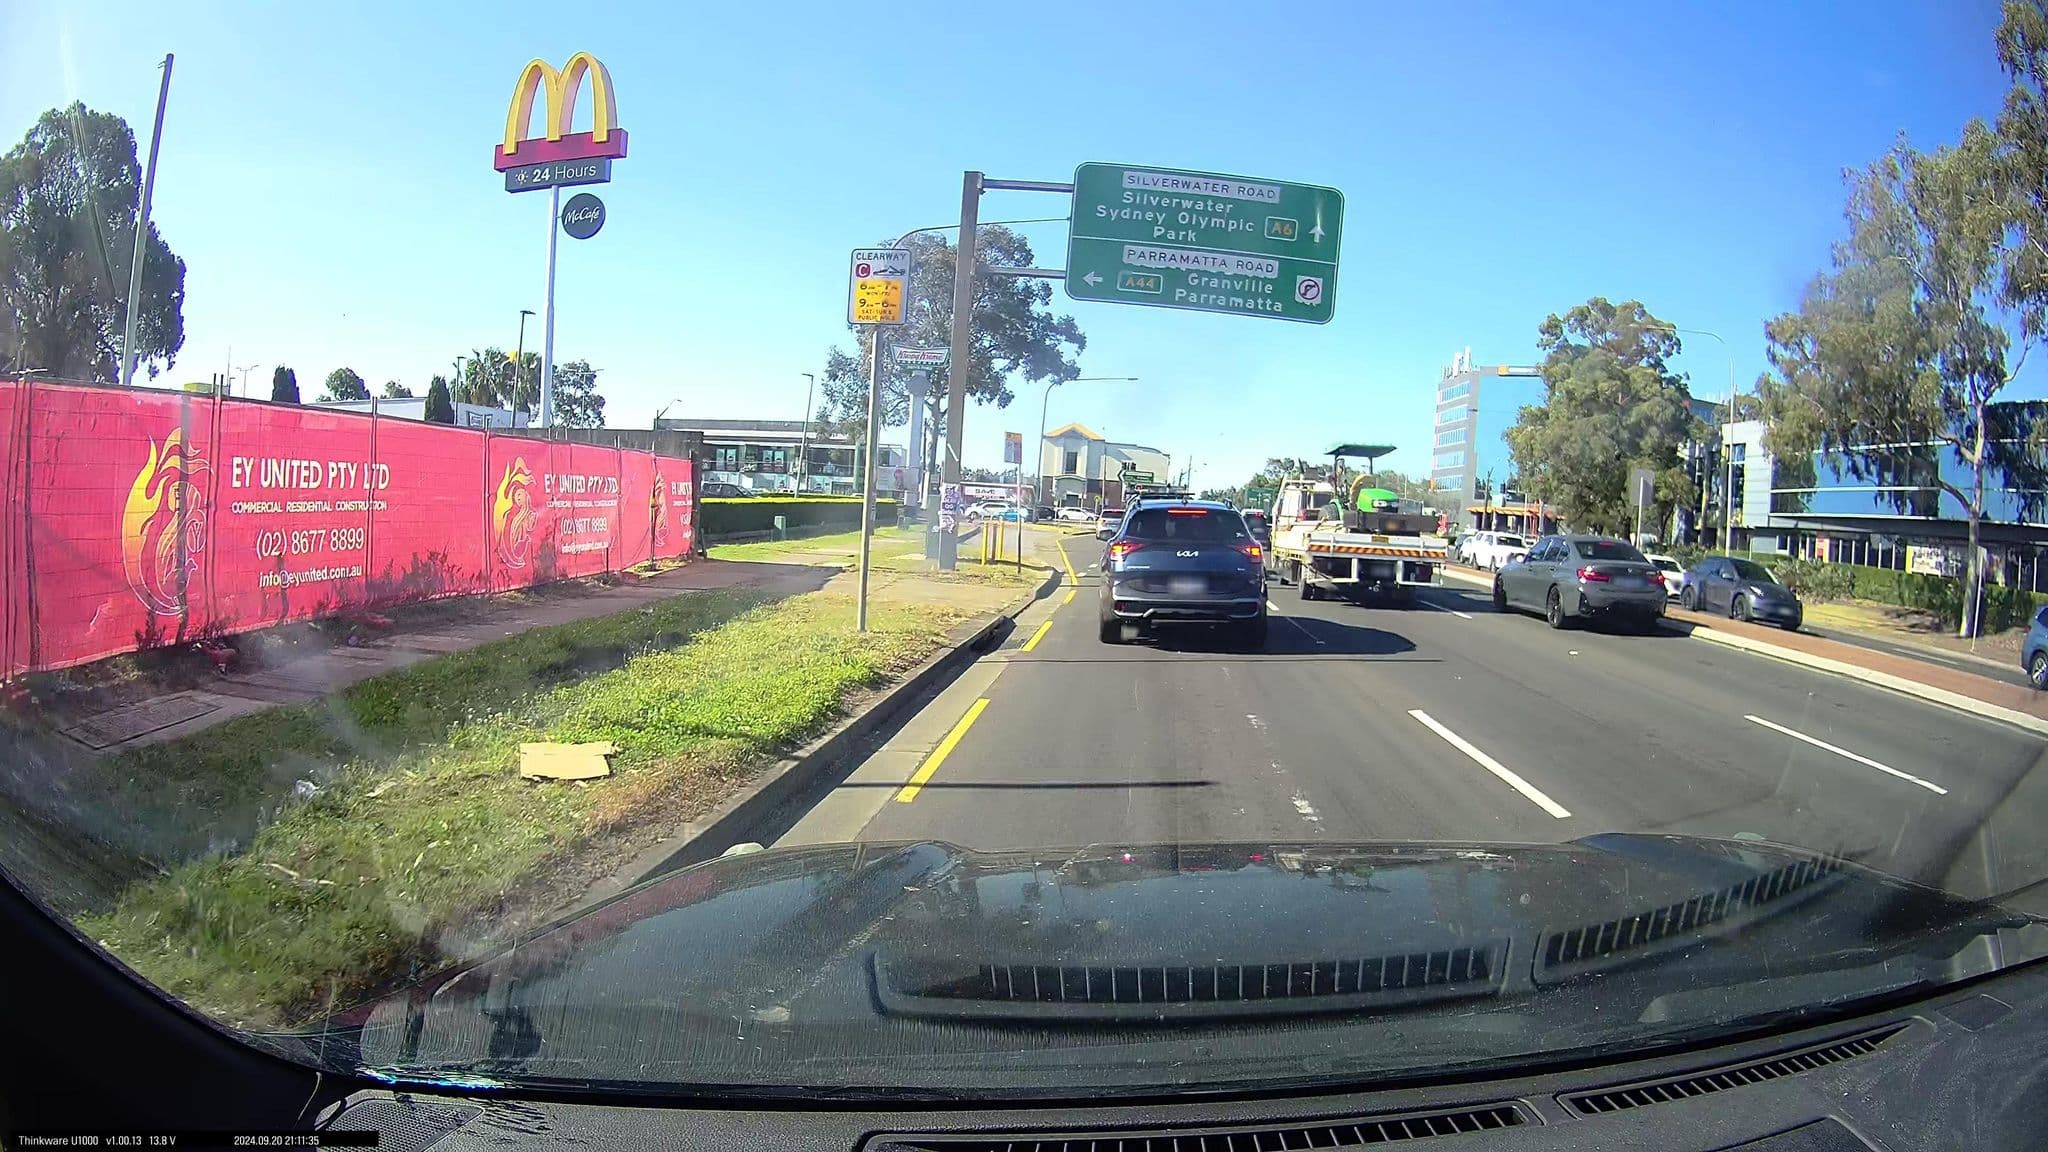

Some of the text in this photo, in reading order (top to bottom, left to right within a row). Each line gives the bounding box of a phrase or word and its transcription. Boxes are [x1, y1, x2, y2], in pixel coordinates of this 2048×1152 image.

[532, 165, 597, 183] 24 Hours
[1127, 174, 1276, 199] SILVERWATER ROAD
[1122, 191, 1233, 214] Silverwater
[1095, 205, 1255, 233] Sydney Olympic
[1270, 220, 1293, 236] A6
[1153, 226, 1197, 242] Park
[855, 252, 907, 261] CLEARWAY
[1127, 249, 1275, 273] PARRAMATTA ROAD
[1125, 273, 1155, 290] A44
[1187, 273, 1273, 295] Granville
[1175, 288, 1283, 313] Parramatta
[231, 456, 390, 490] EY UNITED PTY LTD
[544, 473, 618, 494] EY UNITED PTY LTD
[231, 501, 283, 514] COMMERCIAL
[286, 501, 332, 513] RESIDENTIAL
[256, 528, 365, 560] (02) 8677 8899
[259, 565, 363, 588] info@eyunited.com.au
